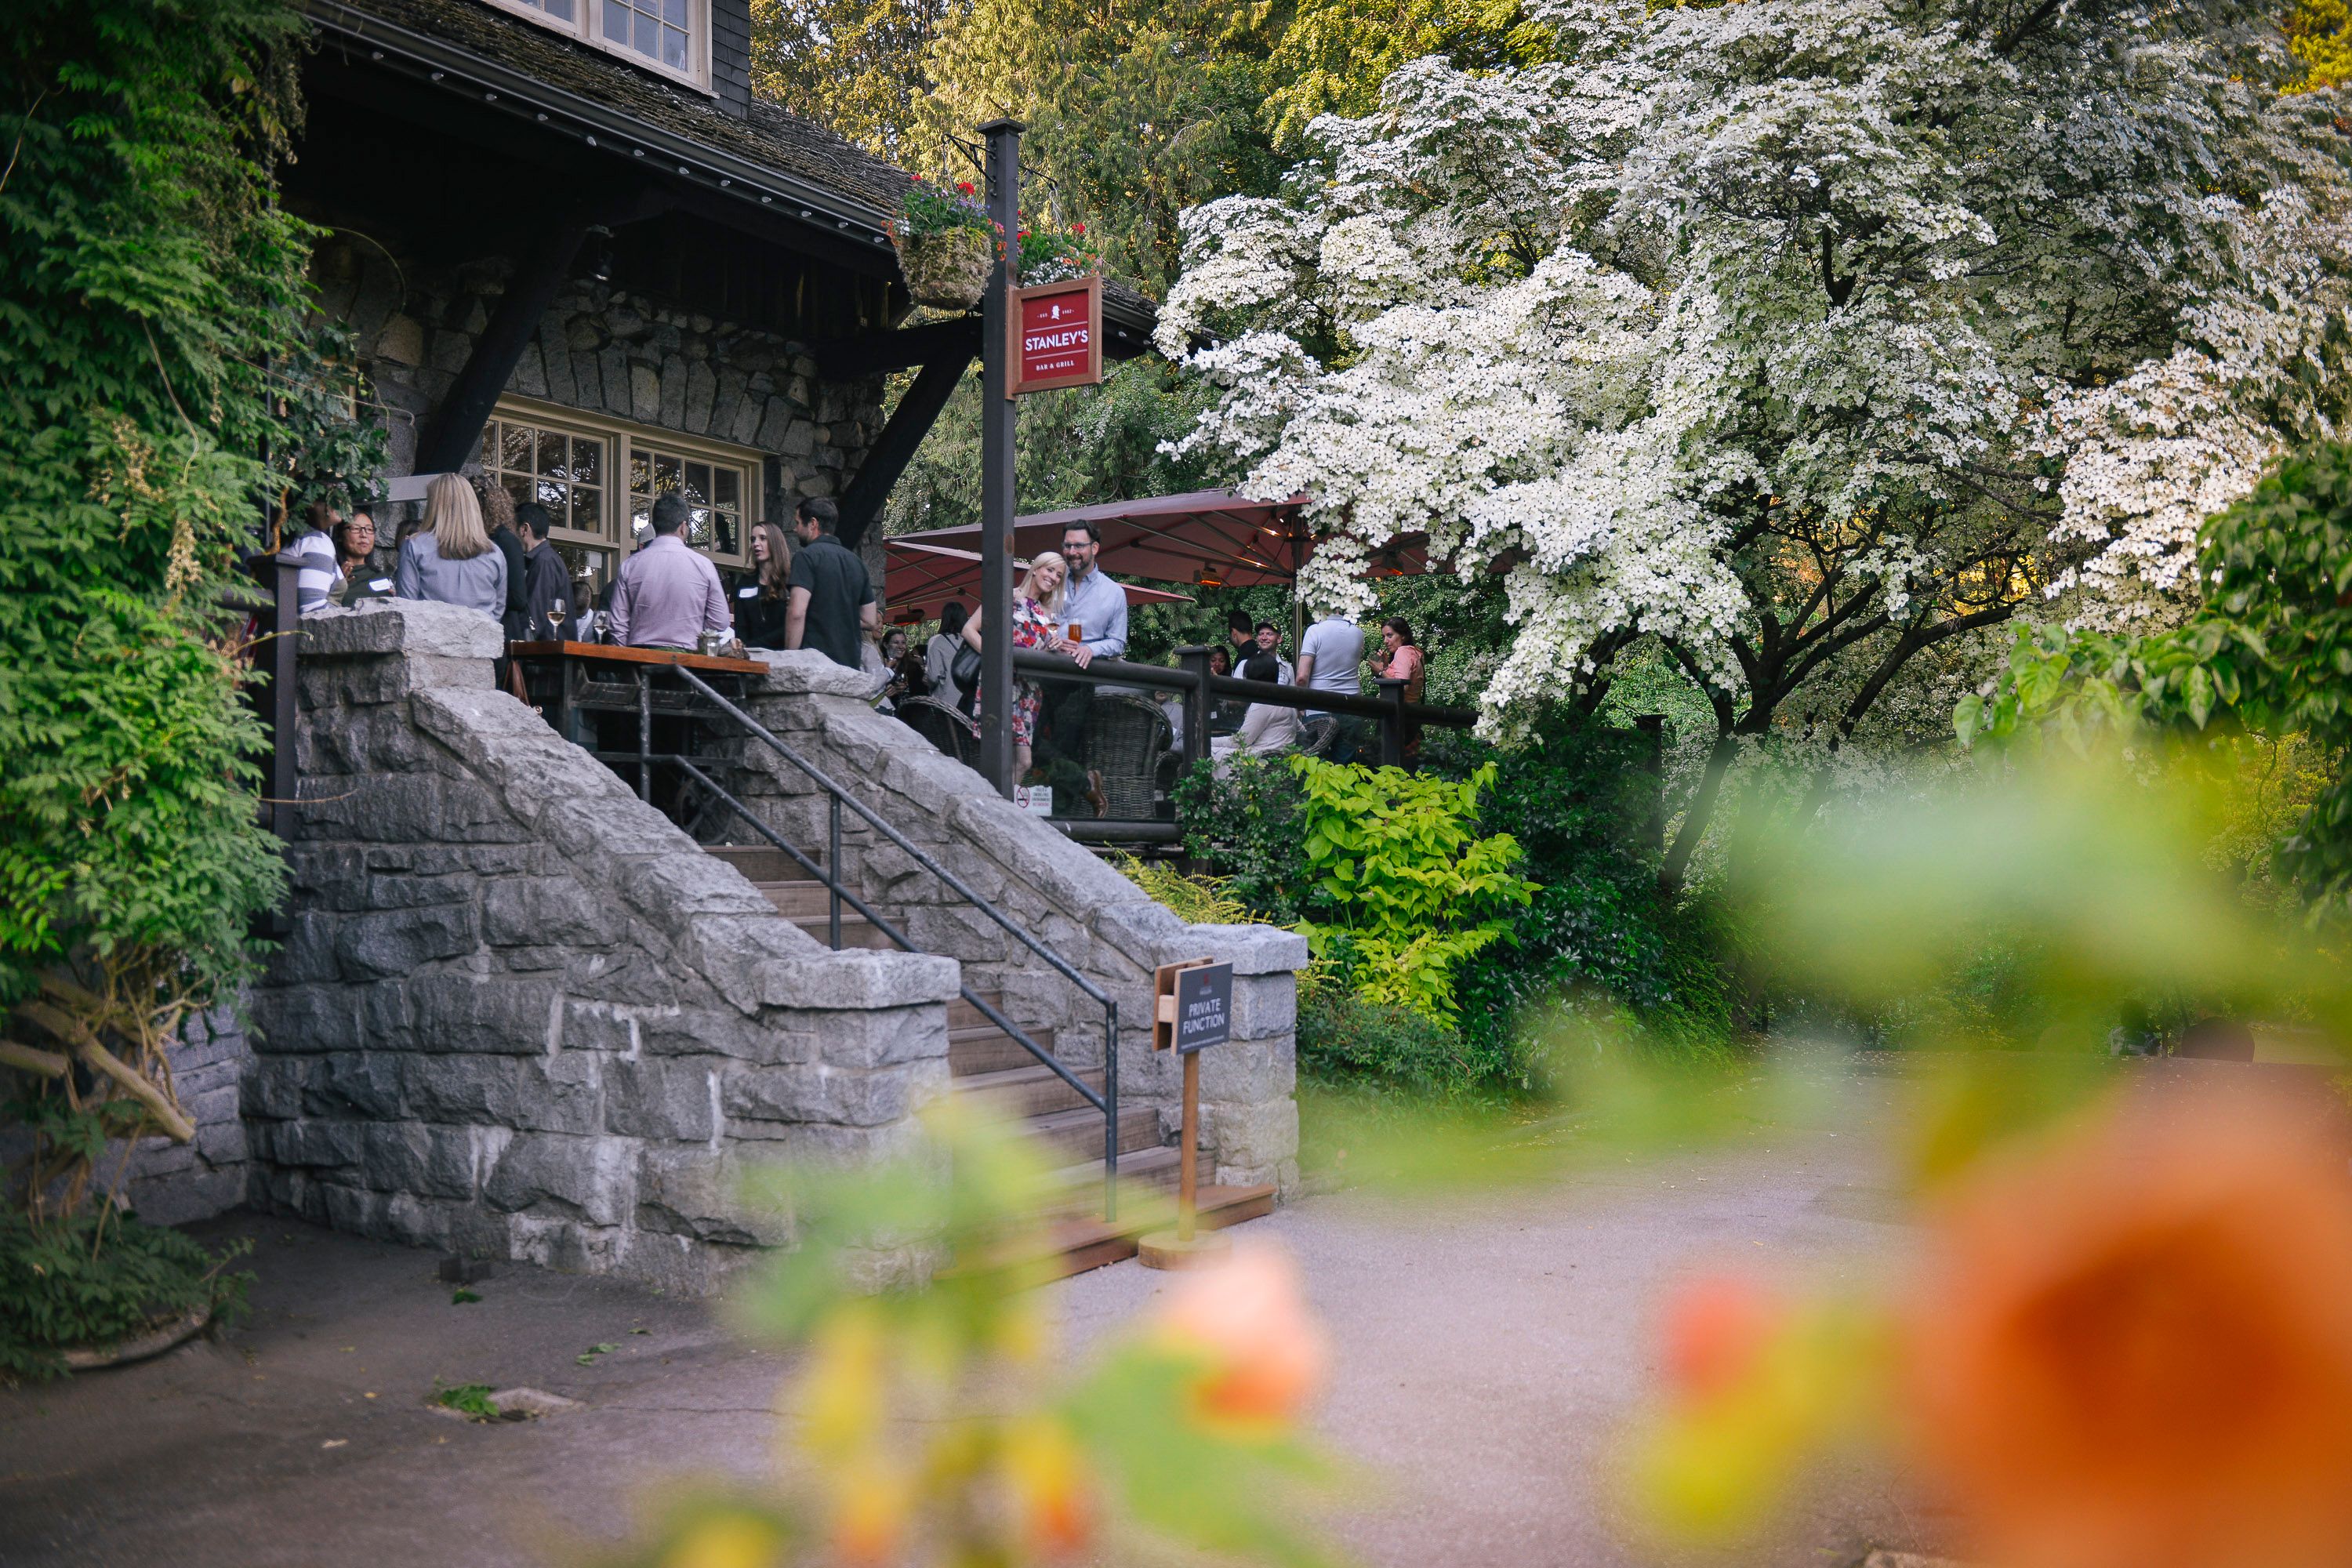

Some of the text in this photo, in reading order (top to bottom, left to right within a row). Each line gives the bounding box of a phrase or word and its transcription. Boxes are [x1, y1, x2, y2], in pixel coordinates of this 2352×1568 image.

[1025, 330, 1088, 352] STANLEY'S
[1055, 360, 1075, 368] GRILL
[1189, 997, 1221, 1018] PRIVATE
[1182, 1012, 1225, 1035] FUNCTION
